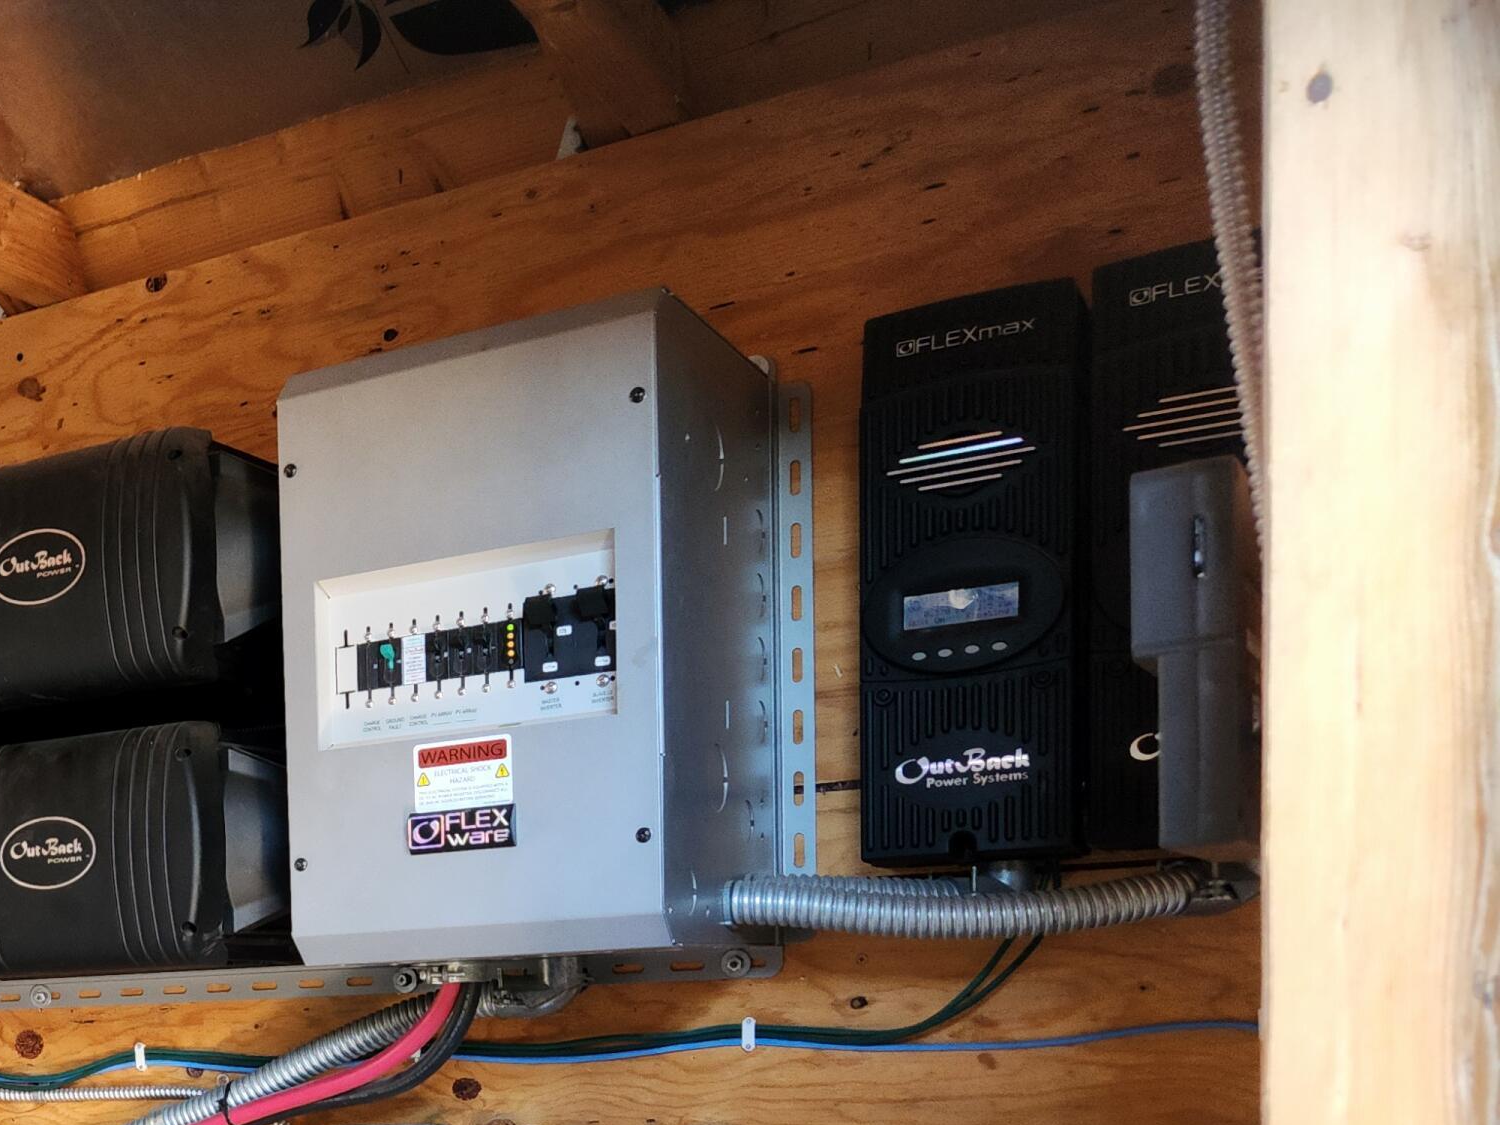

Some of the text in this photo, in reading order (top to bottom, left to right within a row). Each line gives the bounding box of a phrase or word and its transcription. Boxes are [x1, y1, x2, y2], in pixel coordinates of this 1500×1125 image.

[1152, 272, 1222, 302] FLEX
[916, 318, 1036, 353] FLEXmax
[36, 567, 71, 579] POWER
[420, 742, 503, 764] WARNING
[434, 765, 491, 777] ELECTRICAL SHOCK
[926, 771, 1029, 789] Power Systems
[445, 809, 509, 831] FLEX
[446, 829, 510, 847] ware
[47, 855, 82, 864] POWER
